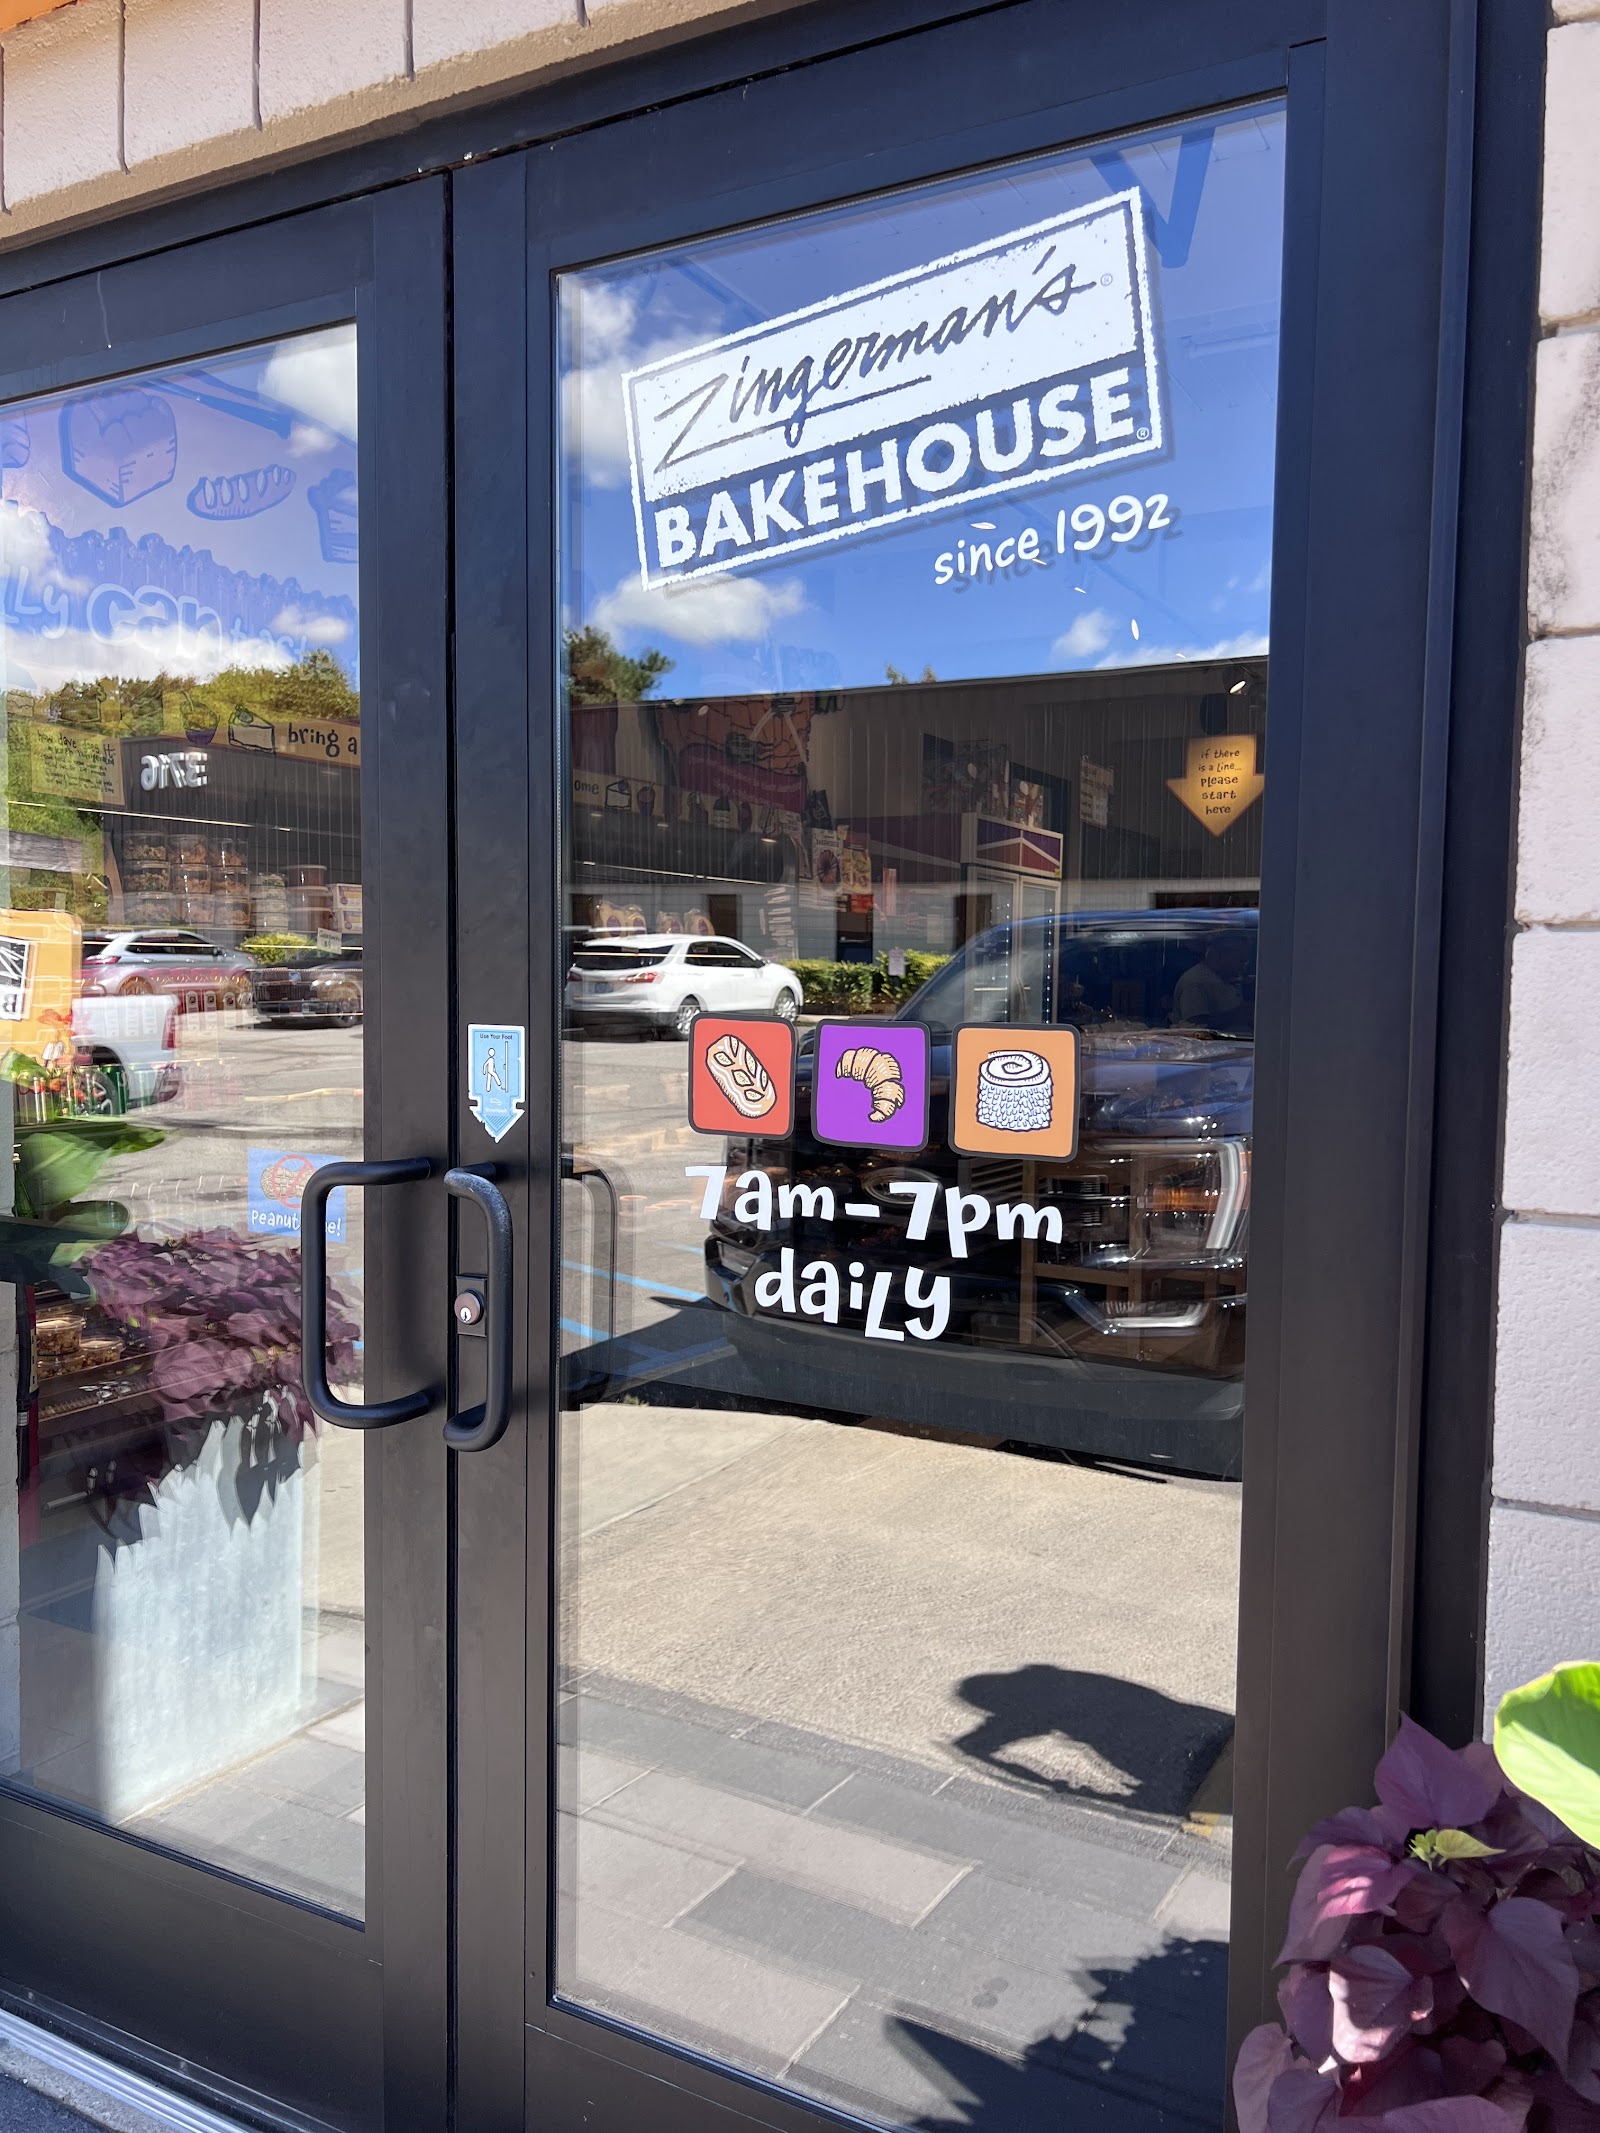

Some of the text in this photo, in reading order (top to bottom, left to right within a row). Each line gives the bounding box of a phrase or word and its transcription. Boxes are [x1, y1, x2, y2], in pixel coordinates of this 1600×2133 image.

[654, 245, 1097, 474] Zingerman's
[654, 367, 1135, 568] BAKEHOUSE
[934, 493, 1171, 585] since 1992
[288, 722, 357, 757] bring a
[1201, 748, 1240, 759] if there
[1198, 763, 1206, 772] is
[1208, 764, 1214, 772] a
[1201, 790, 1237, 801] start
[1205, 805, 1231, 815] here
